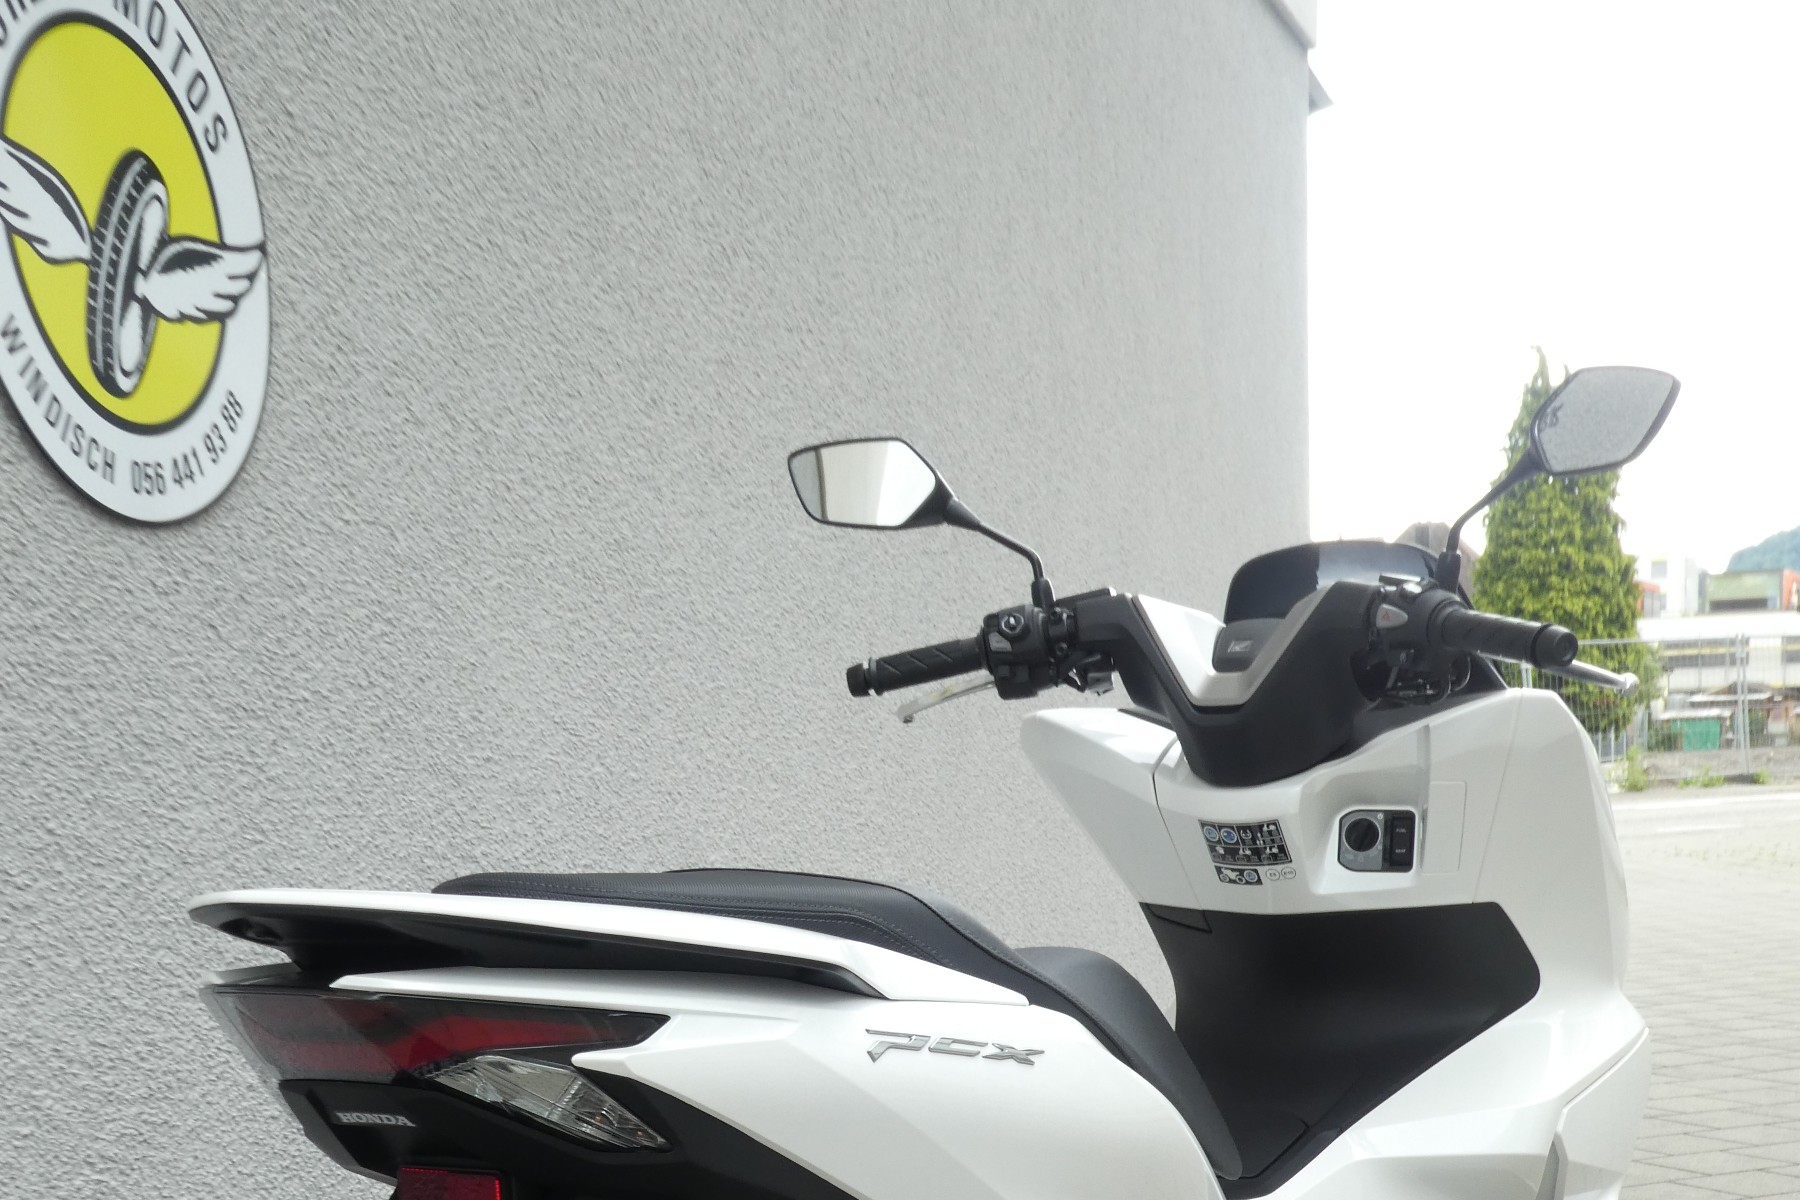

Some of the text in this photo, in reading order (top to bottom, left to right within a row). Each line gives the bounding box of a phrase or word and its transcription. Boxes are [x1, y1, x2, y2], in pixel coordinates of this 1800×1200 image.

[1, 312, 245, 496] WINDISCH 056 441 93 88
[865, 1028, 1045, 1066] PCX
[336, 1111, 417, 1127] HONDA
